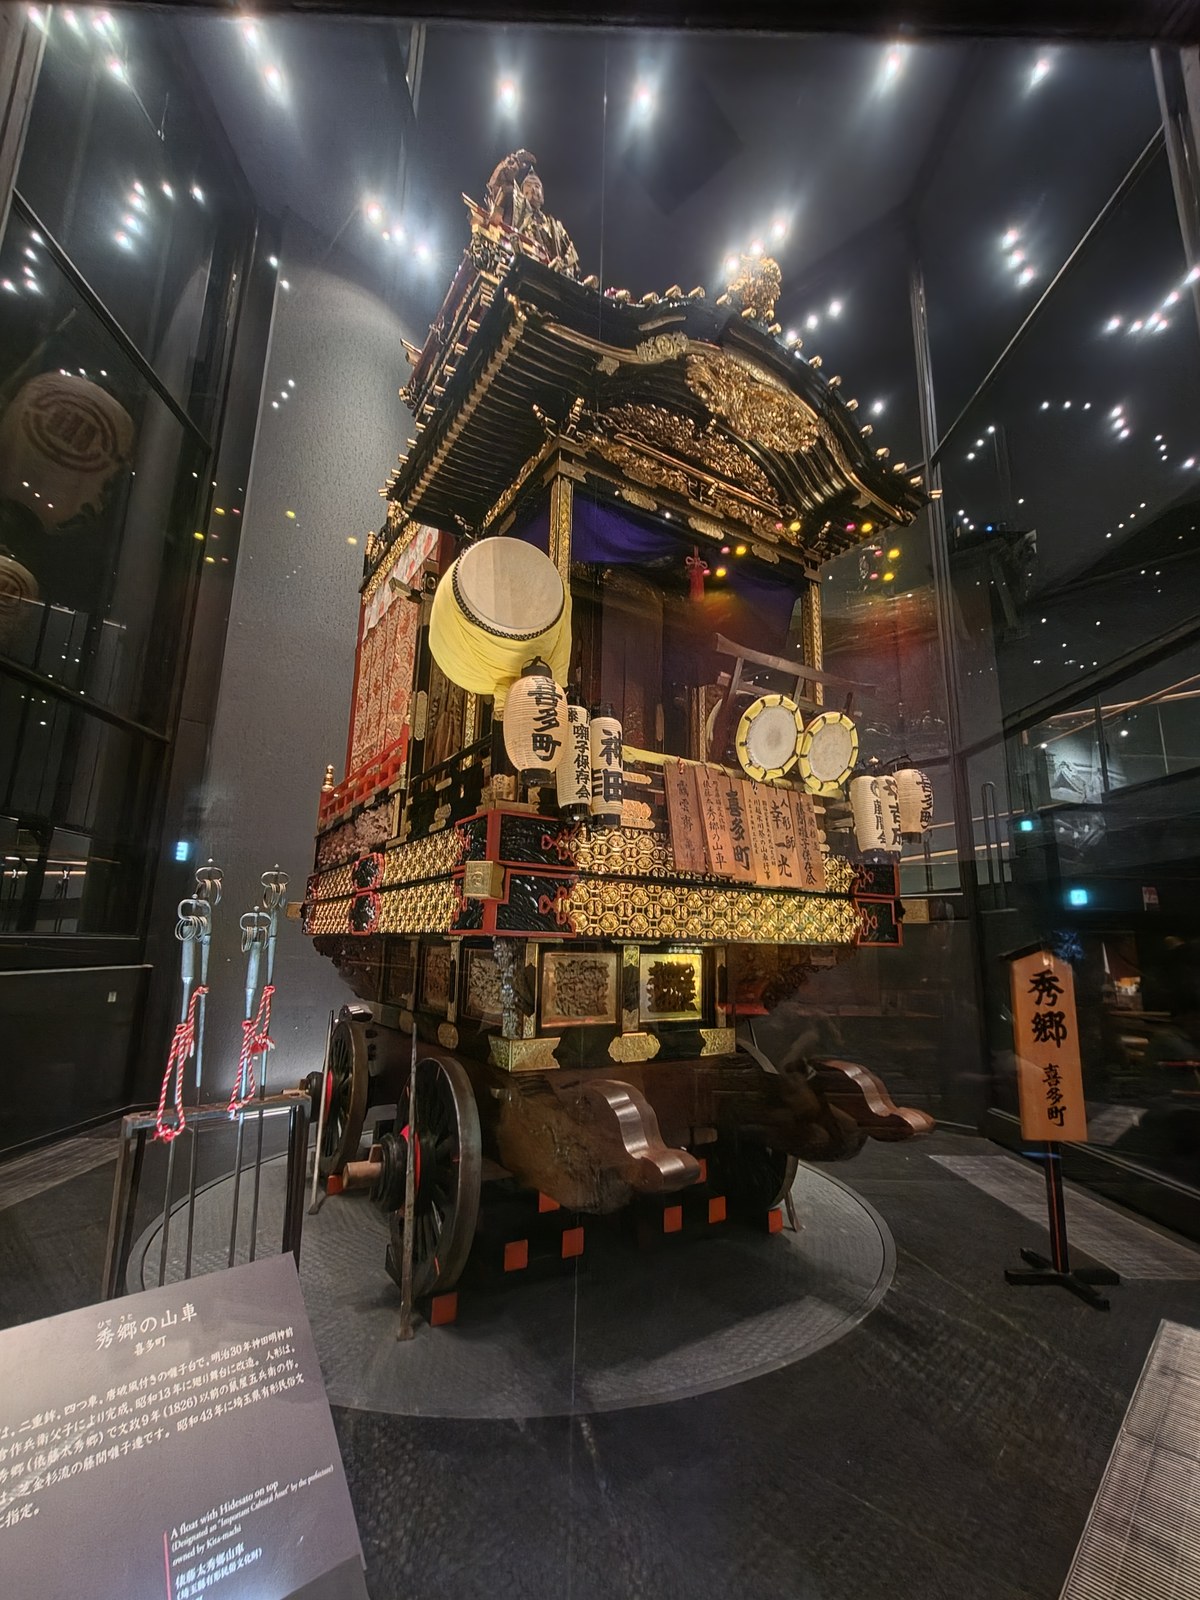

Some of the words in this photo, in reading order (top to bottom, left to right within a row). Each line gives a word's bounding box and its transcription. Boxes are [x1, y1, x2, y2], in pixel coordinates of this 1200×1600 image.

[527, 677, 563, 762] 喜多町
[572, 723, 591, 799] 囃子保存会
[599, 728, 624, 802] 神田
[725, 790, 751, 872] 喜多町
[770, 800, 793, 878] 幸一光
[780, 798, 796, 853] 人形師
[1027, 968, 1068, 1049] 秀郷
[1042, 1062, 1067, 1128] 喜多町
[96, 1302, 198, 1351] 秀郷の山車
[134, 1335, 167, 1358] 喜多町
[170, 1527, 179, 1541] A
[180, 1519, 199, 1537] float
[200, 1508, 219, 1525] with
[219, 1492, 254, 1517] Hidesato
[254, 1489, 265, 1500] on
[266, 1480, 280, 1496] top
[172, 1549, 196, 1566] owned
[196, 1544, 206, 1554] by
